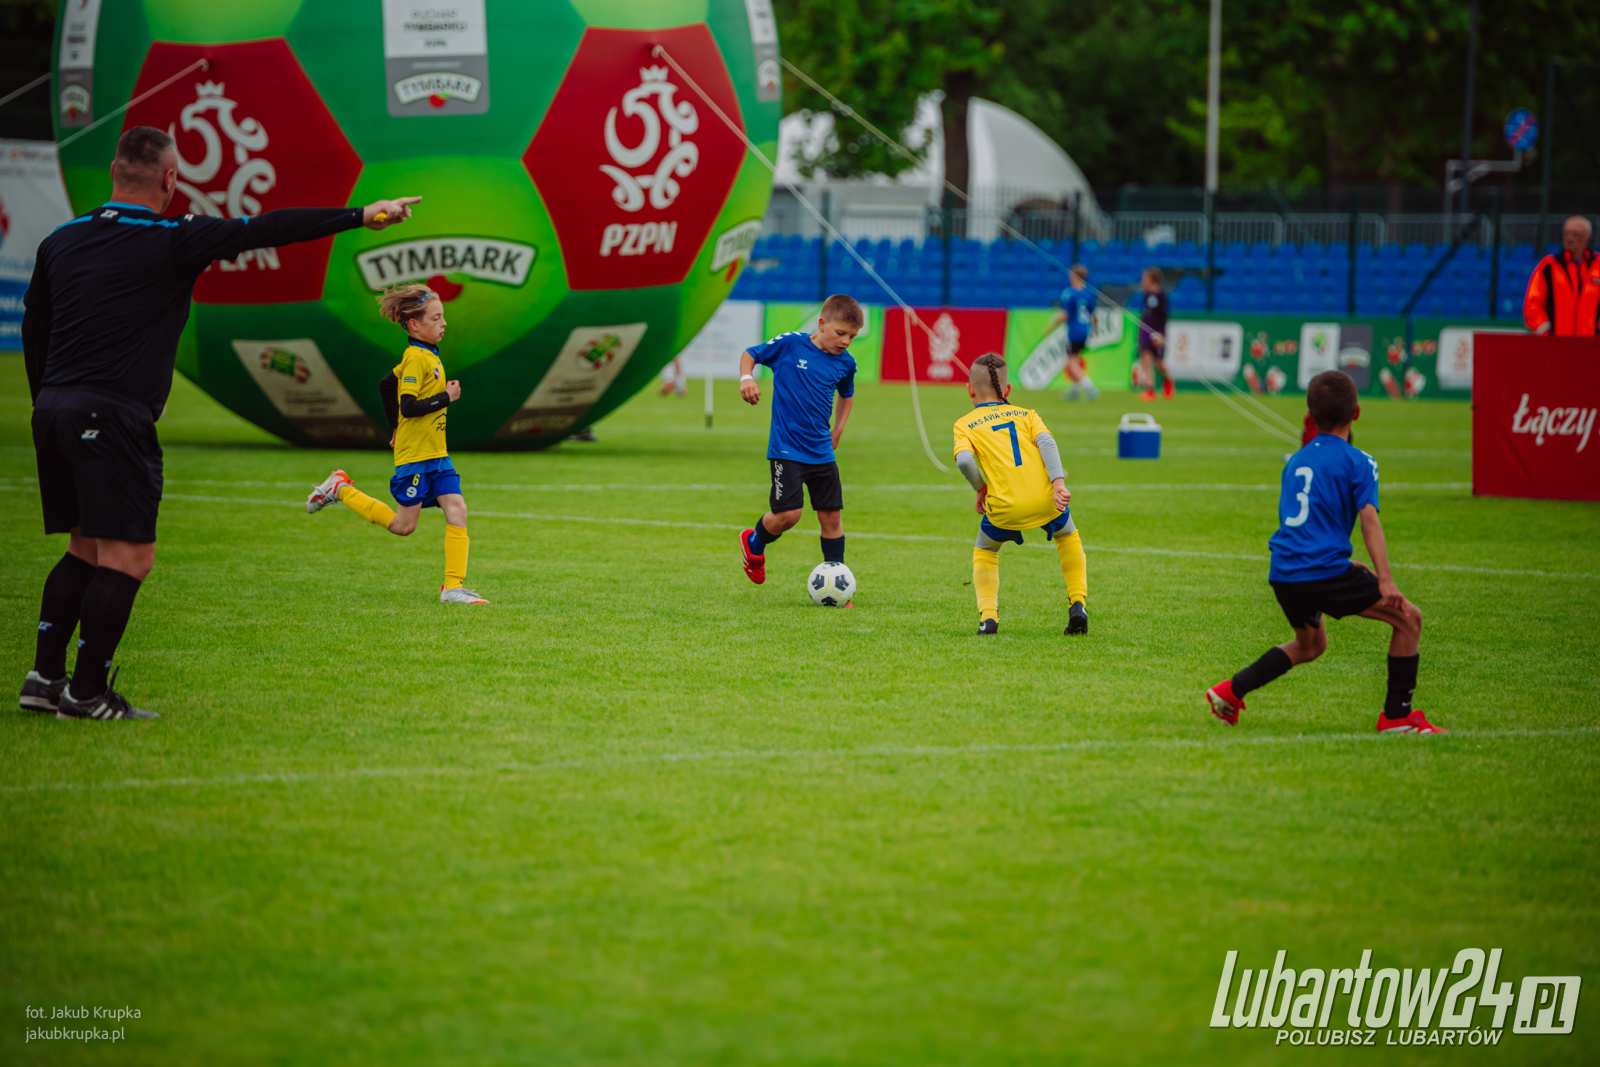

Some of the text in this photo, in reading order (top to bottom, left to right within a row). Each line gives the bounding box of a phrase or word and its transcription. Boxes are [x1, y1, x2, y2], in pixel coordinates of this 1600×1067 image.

[204, 246, 281, 272] PN
[600, 221, 677, 257] PZPN
[367, 246, 523, 281] TYMBARK
[1511, 392, 1597, 453] Łączy
[991, 420, 1023, 467] 7
[1285, 466, 1314, 527] 3
